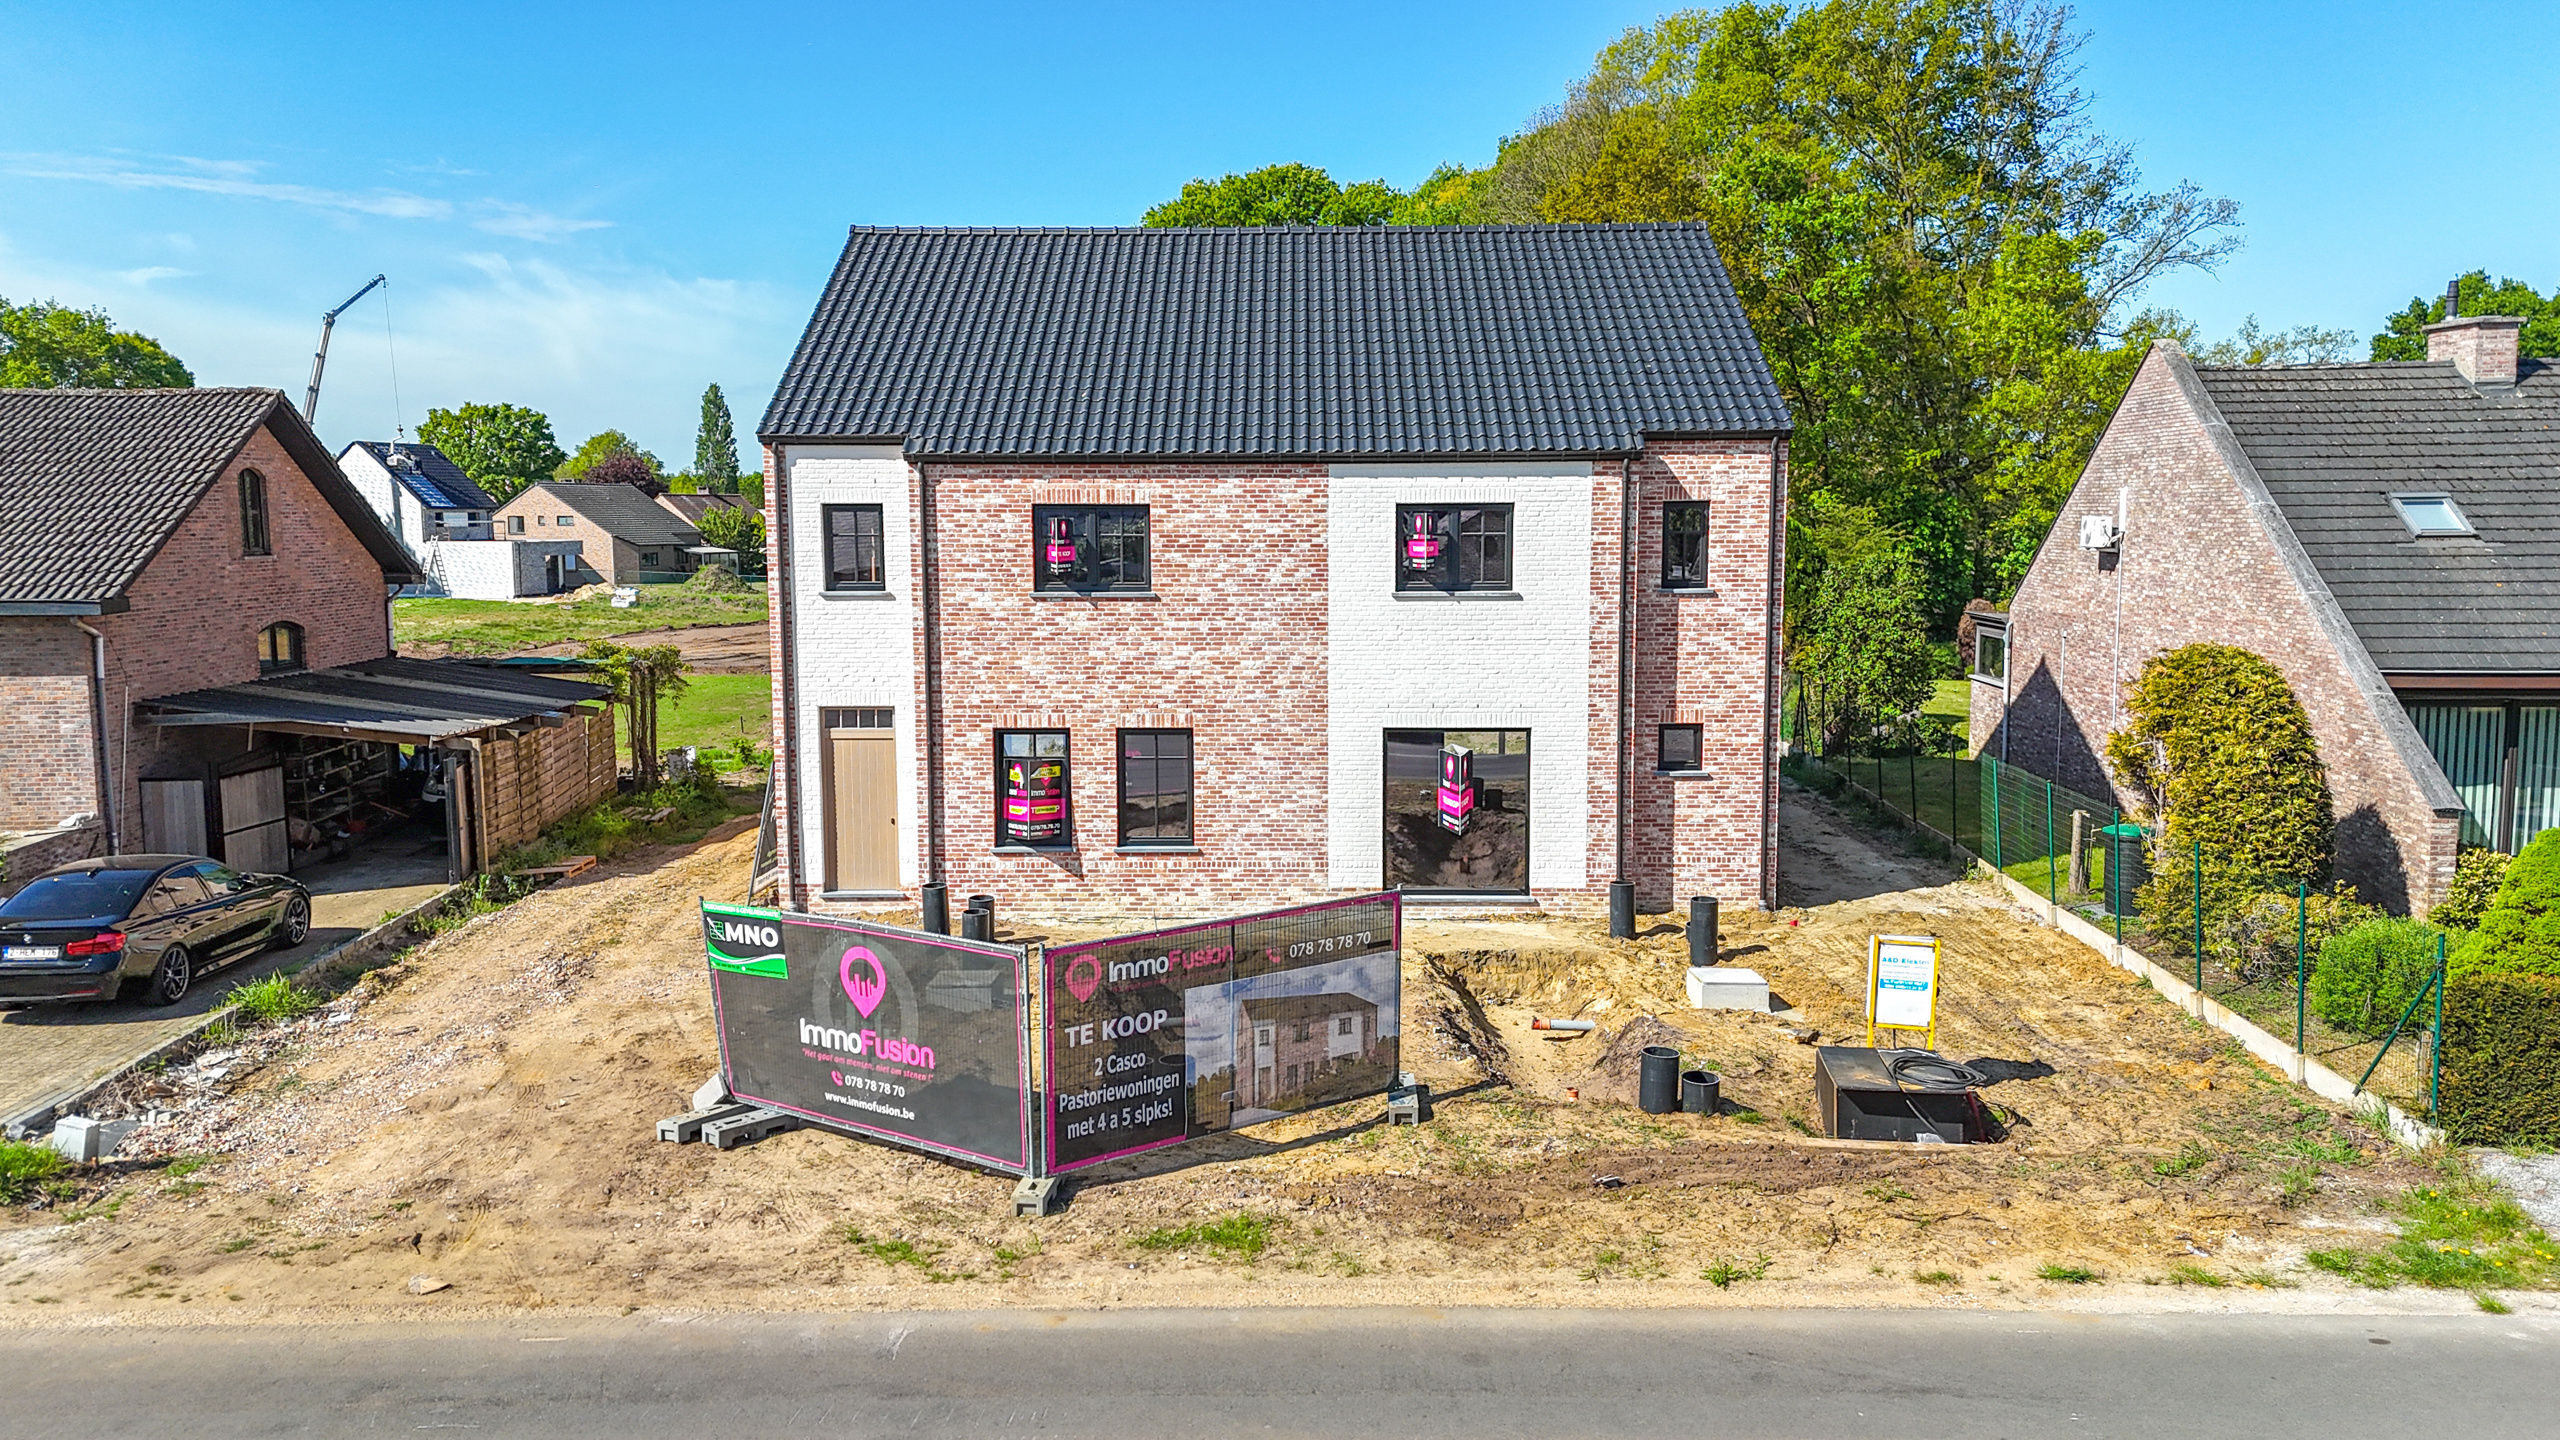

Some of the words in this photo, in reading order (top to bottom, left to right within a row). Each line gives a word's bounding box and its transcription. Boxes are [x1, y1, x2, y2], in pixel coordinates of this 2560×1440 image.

[724, 922, 779, 948] MNO
[1289, 941, 1314, 958] 078
[1317, 938, 1334, 953] 78
[1337, 935, 1353, 950] 78
[1356, 931, 1371, 946] 70
[1108, 945, 1233, 982] ImmoFusion
[1064, 1023, 1094, 1048] TE
[1102, 1009, 1168, 1041] KOOP
[800, 1018, 936, 1069] ImmoFusion
[834, 1056, 845, 1064] om
[875, 1065, 890, 1075] niet
[890, 1068, 902, 1076] om
[903, 1069, 926, 1081] stenen
[1094, 1057, 1103, 1077] 2
[1106, 1052, 1146, 1074] Casco
[845, 1075, 863, 1088] 078
[864, 1079, 877, 1091] 78
[878, 1081, 891, 1094] 78
[892, 1085, 905, 1097] 70
[1059, 1072, 1180, 1113] Pastoriewoningen
[824, 1092, 915, 1120] www.immofusion.be
[1067, 1116, 1095, 1140] met
[1097, 1112, 1106, 1131] 4
[1110, 1114, 1118, 1129] a
[1121, 1107, 1131, 1126] 5
[1134, 1097, 1173, 1126] slpks!
